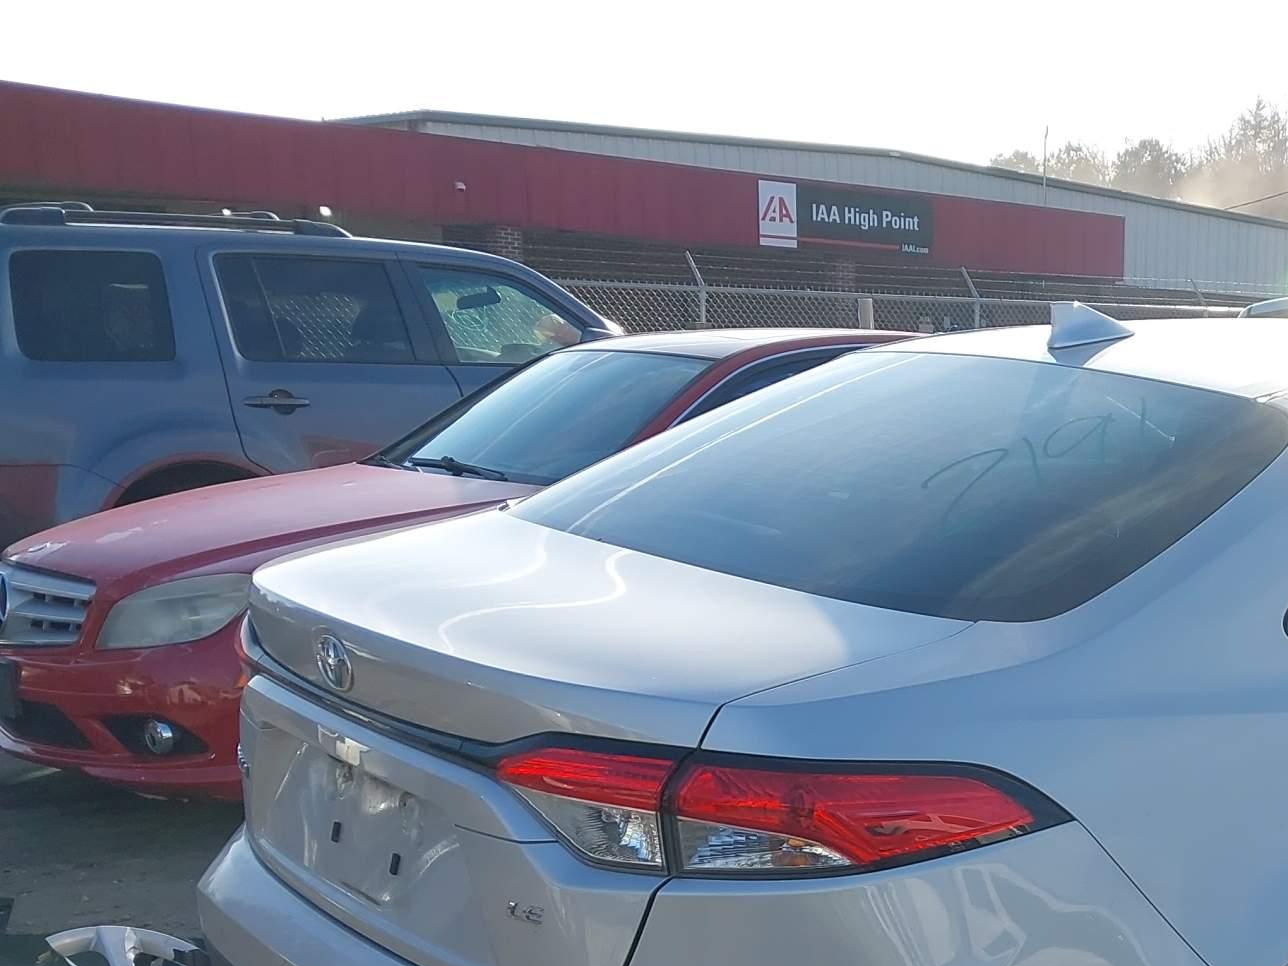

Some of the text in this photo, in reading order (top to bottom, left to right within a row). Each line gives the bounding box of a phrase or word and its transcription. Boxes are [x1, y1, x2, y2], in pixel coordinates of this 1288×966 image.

[812, 203, 920, 231] IAA High Point
